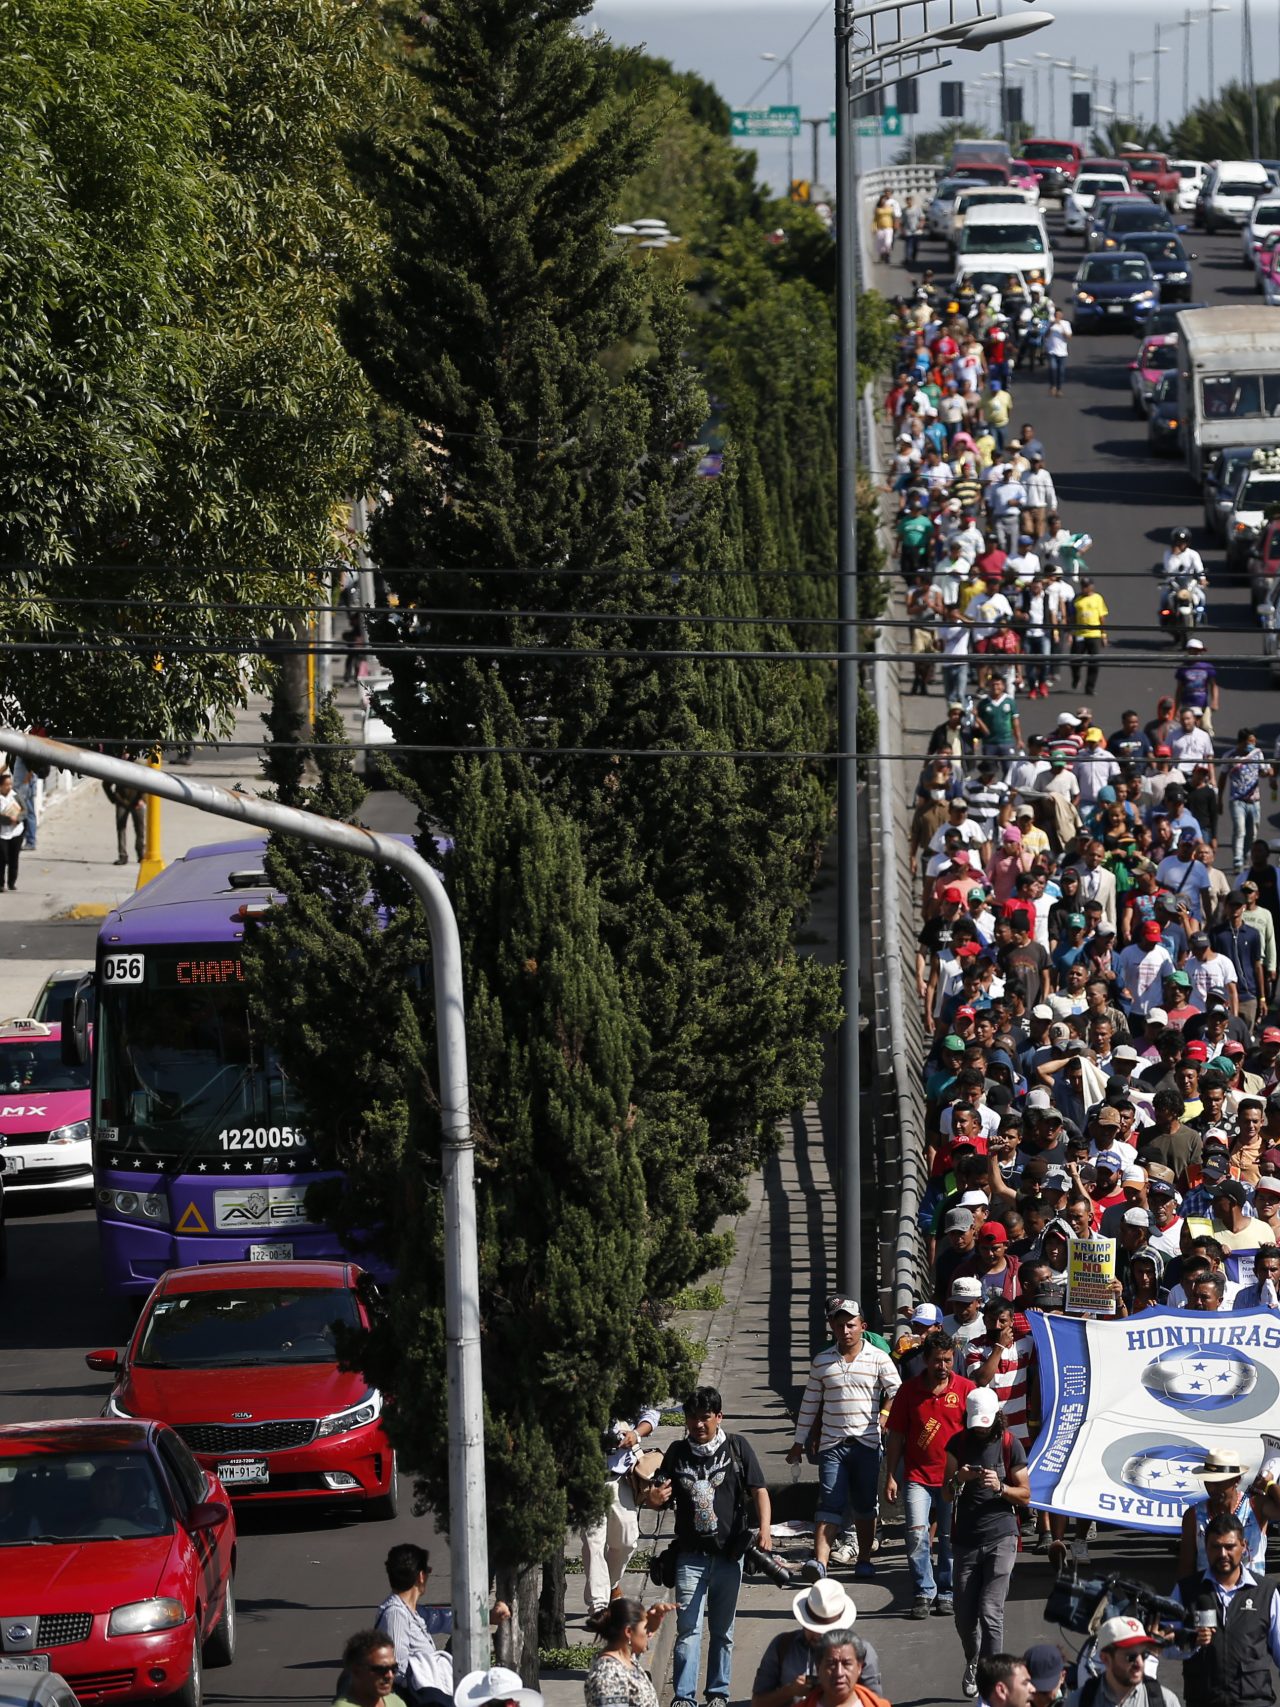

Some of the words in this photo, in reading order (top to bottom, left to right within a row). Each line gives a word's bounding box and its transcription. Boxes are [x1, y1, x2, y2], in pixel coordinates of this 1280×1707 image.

[105, 959, 140, 979] 056
[14, 1021, 31, 1029] TAXI
[218, 1127, 307, 1150] 1220056
[1074, 1243, 1110, 1252] TRUMP
[252, 1250, 292, 1260] 122-00-56
[1073, 1252, 1111, 1262] MEXICO
[1082, 1262, 1102, 1273] NO
[1063, 1365, 1087, 1397] 2010
